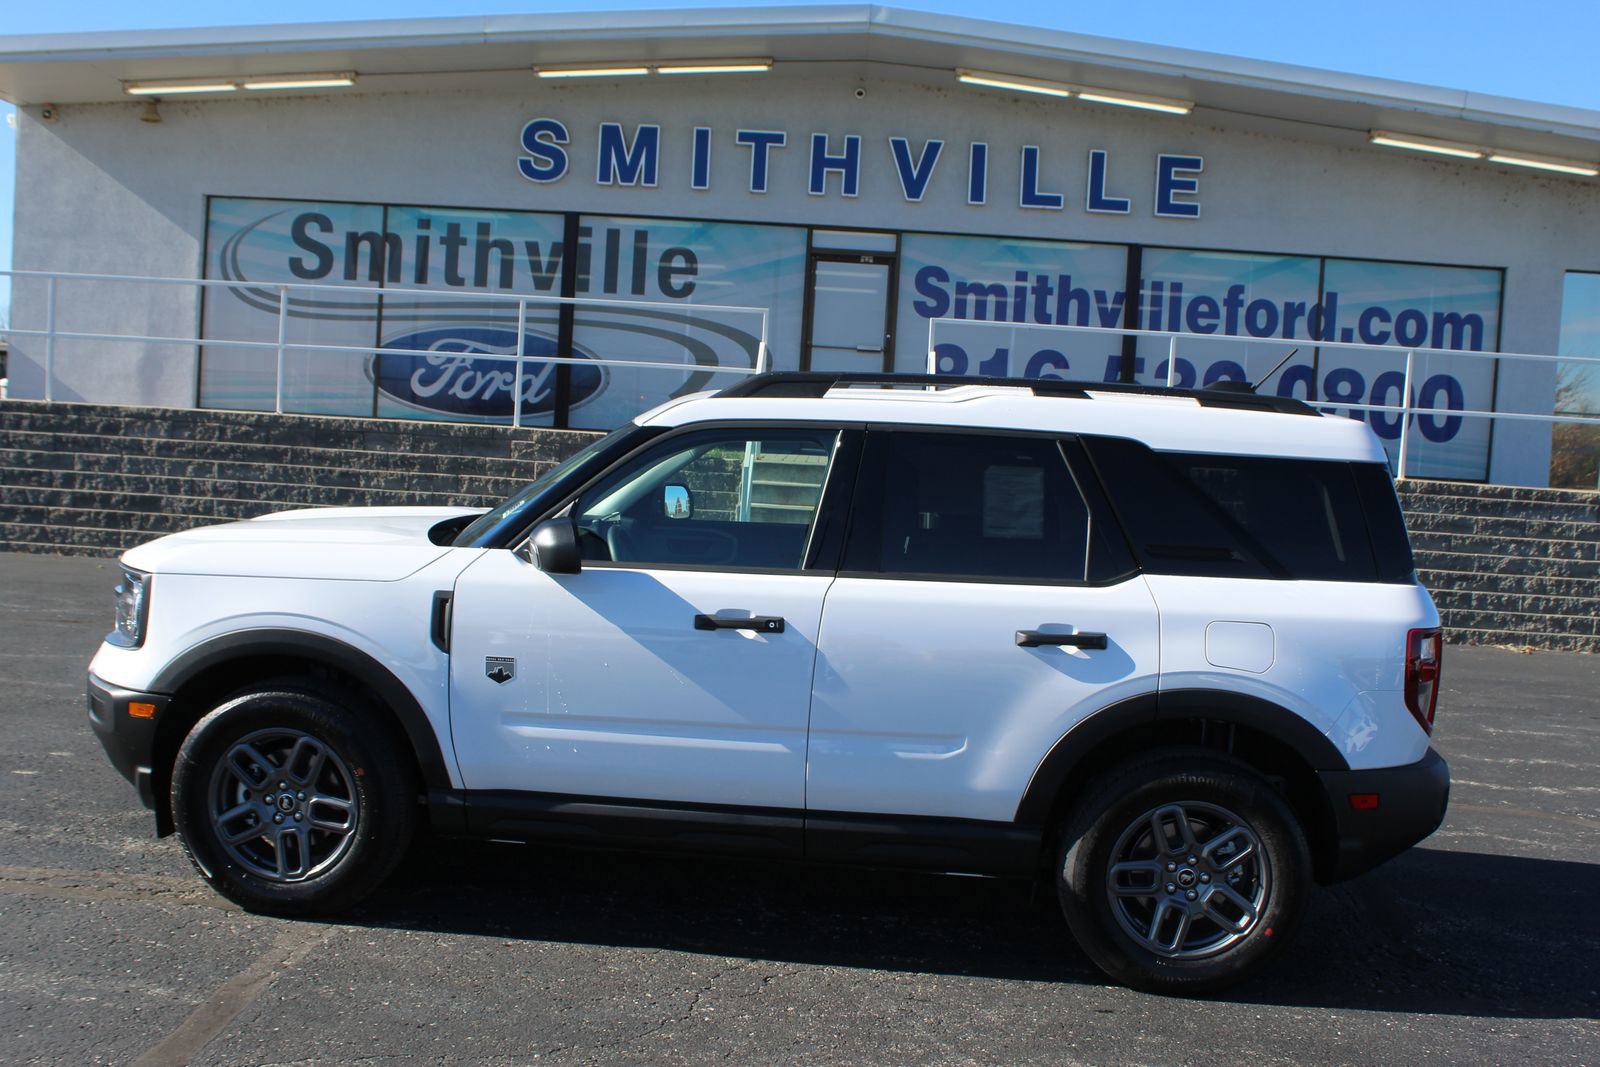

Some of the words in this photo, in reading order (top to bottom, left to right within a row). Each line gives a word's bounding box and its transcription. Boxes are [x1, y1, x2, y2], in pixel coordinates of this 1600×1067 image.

[517, 118, 1203, 217] SMITHVILLE
[288, 212, 699, 299] Smithville
[410, 338, 552, 404] Ford
